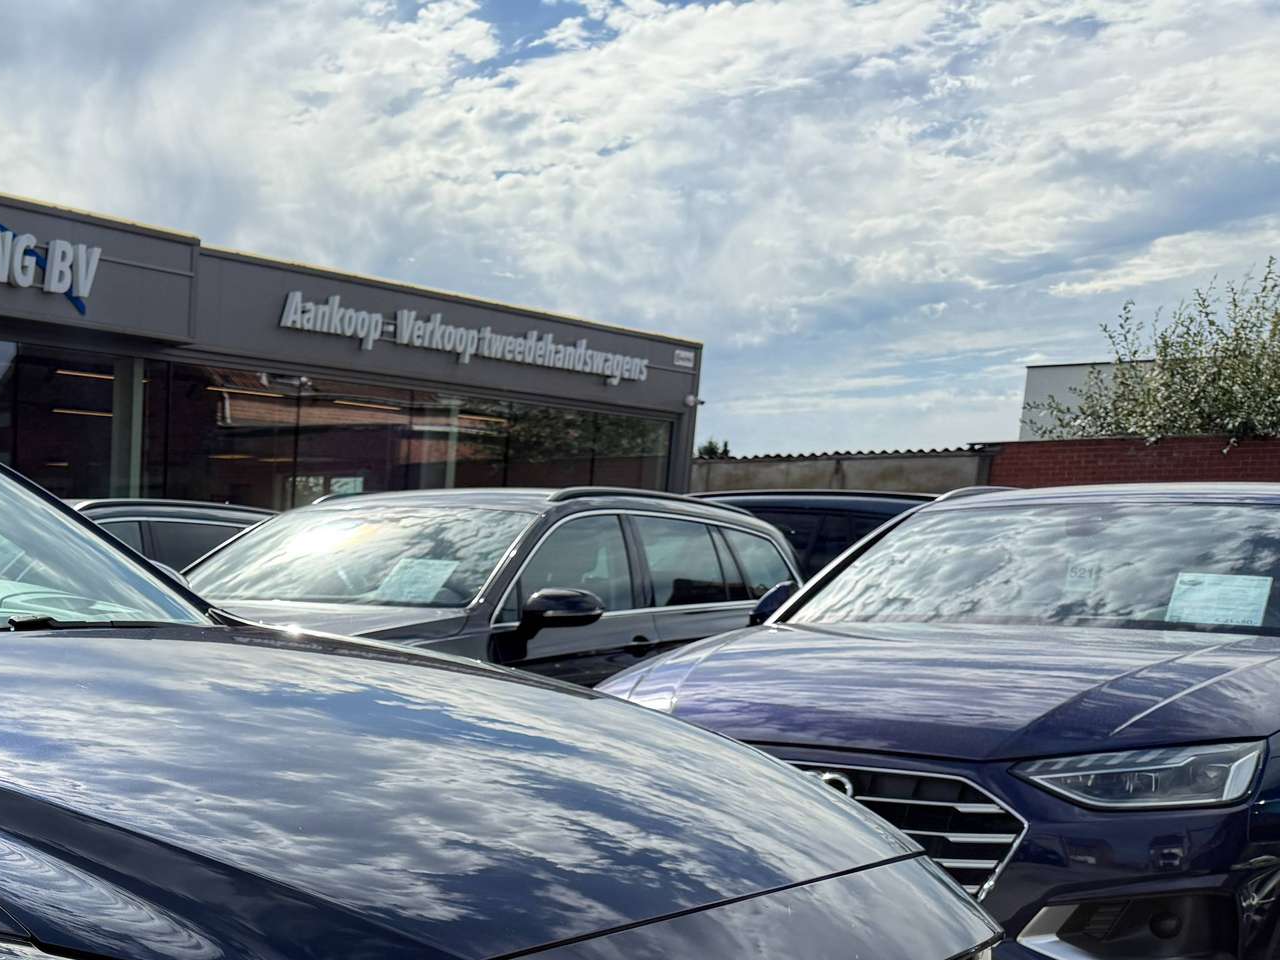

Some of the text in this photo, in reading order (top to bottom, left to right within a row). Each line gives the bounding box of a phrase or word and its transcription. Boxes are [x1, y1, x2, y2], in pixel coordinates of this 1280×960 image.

[43, 239, 102, 298] BV
[280, 291, 383, 350] Aankoop
[396, 309, 478, 364] Verkoop
[477, 326, 649, 386] tweedehandswagens
